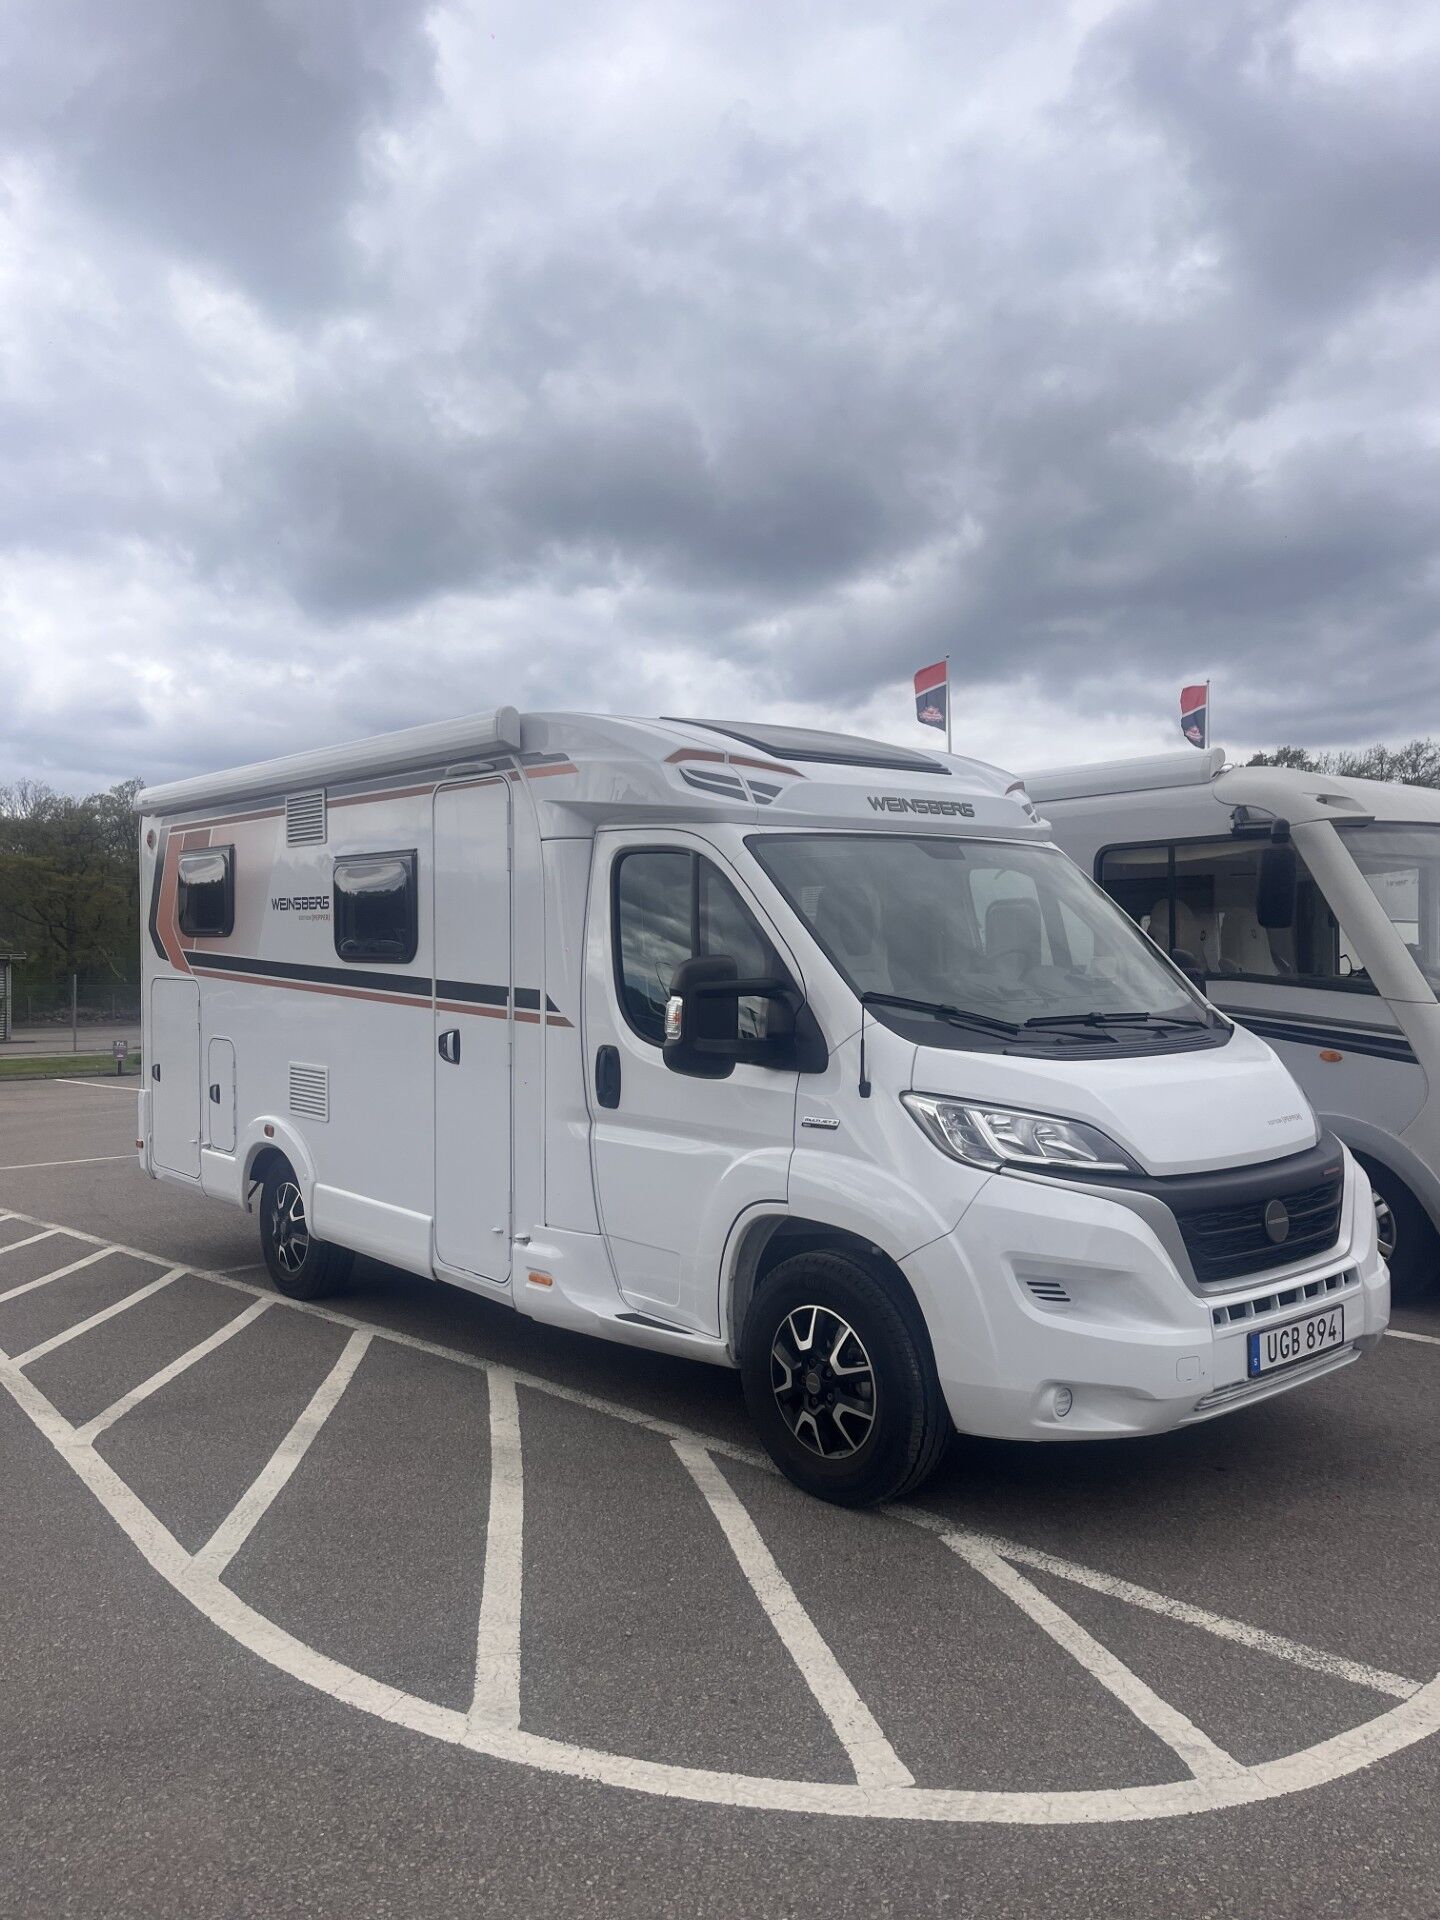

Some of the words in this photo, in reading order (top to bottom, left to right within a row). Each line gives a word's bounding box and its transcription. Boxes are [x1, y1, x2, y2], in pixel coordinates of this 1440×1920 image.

[867, 796, 975, 817] WEINSBERG
[271, 896, 330, 911] WEINSBERG
[1267, 1326, 1300, 1363] UGB
[1306, 1314, 1337, 1349] 894
